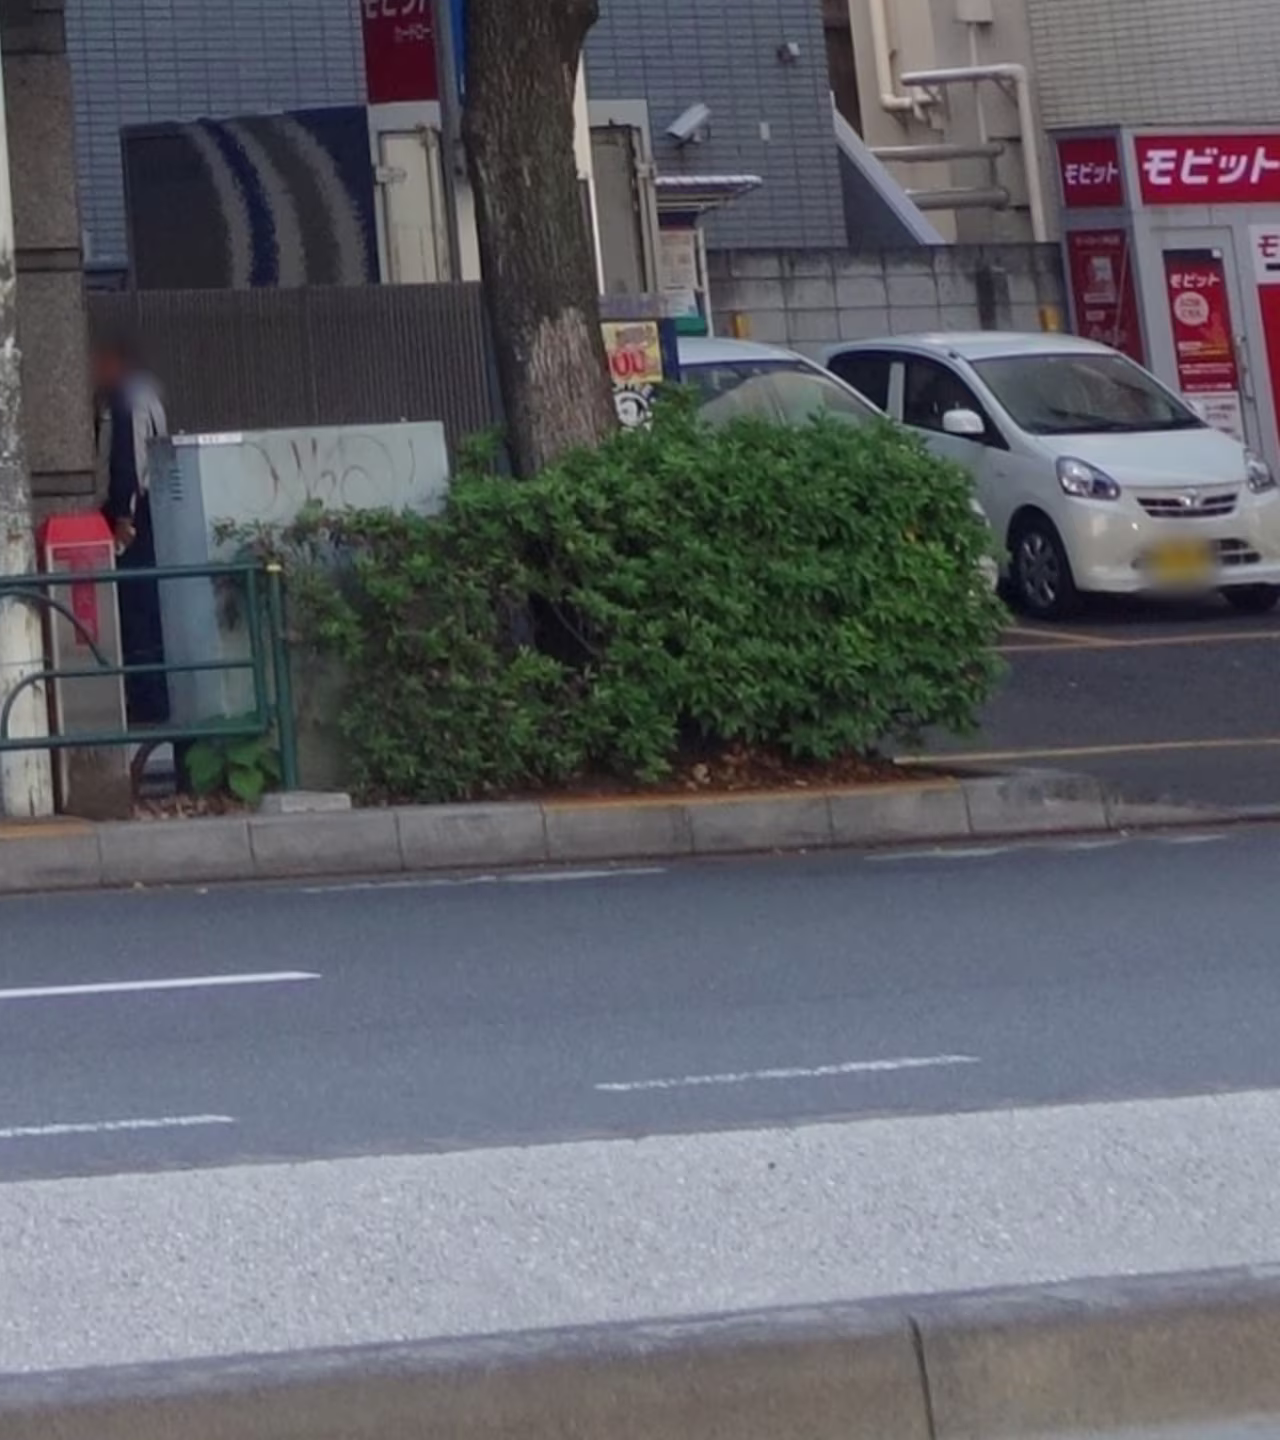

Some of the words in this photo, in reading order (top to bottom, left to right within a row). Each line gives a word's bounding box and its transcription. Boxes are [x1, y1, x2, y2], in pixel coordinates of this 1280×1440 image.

[1065, 162, 1119, 185] モビット
[1143, 146, 1280, 185] モビット
[1170, 273, 1220, 288] モビット
